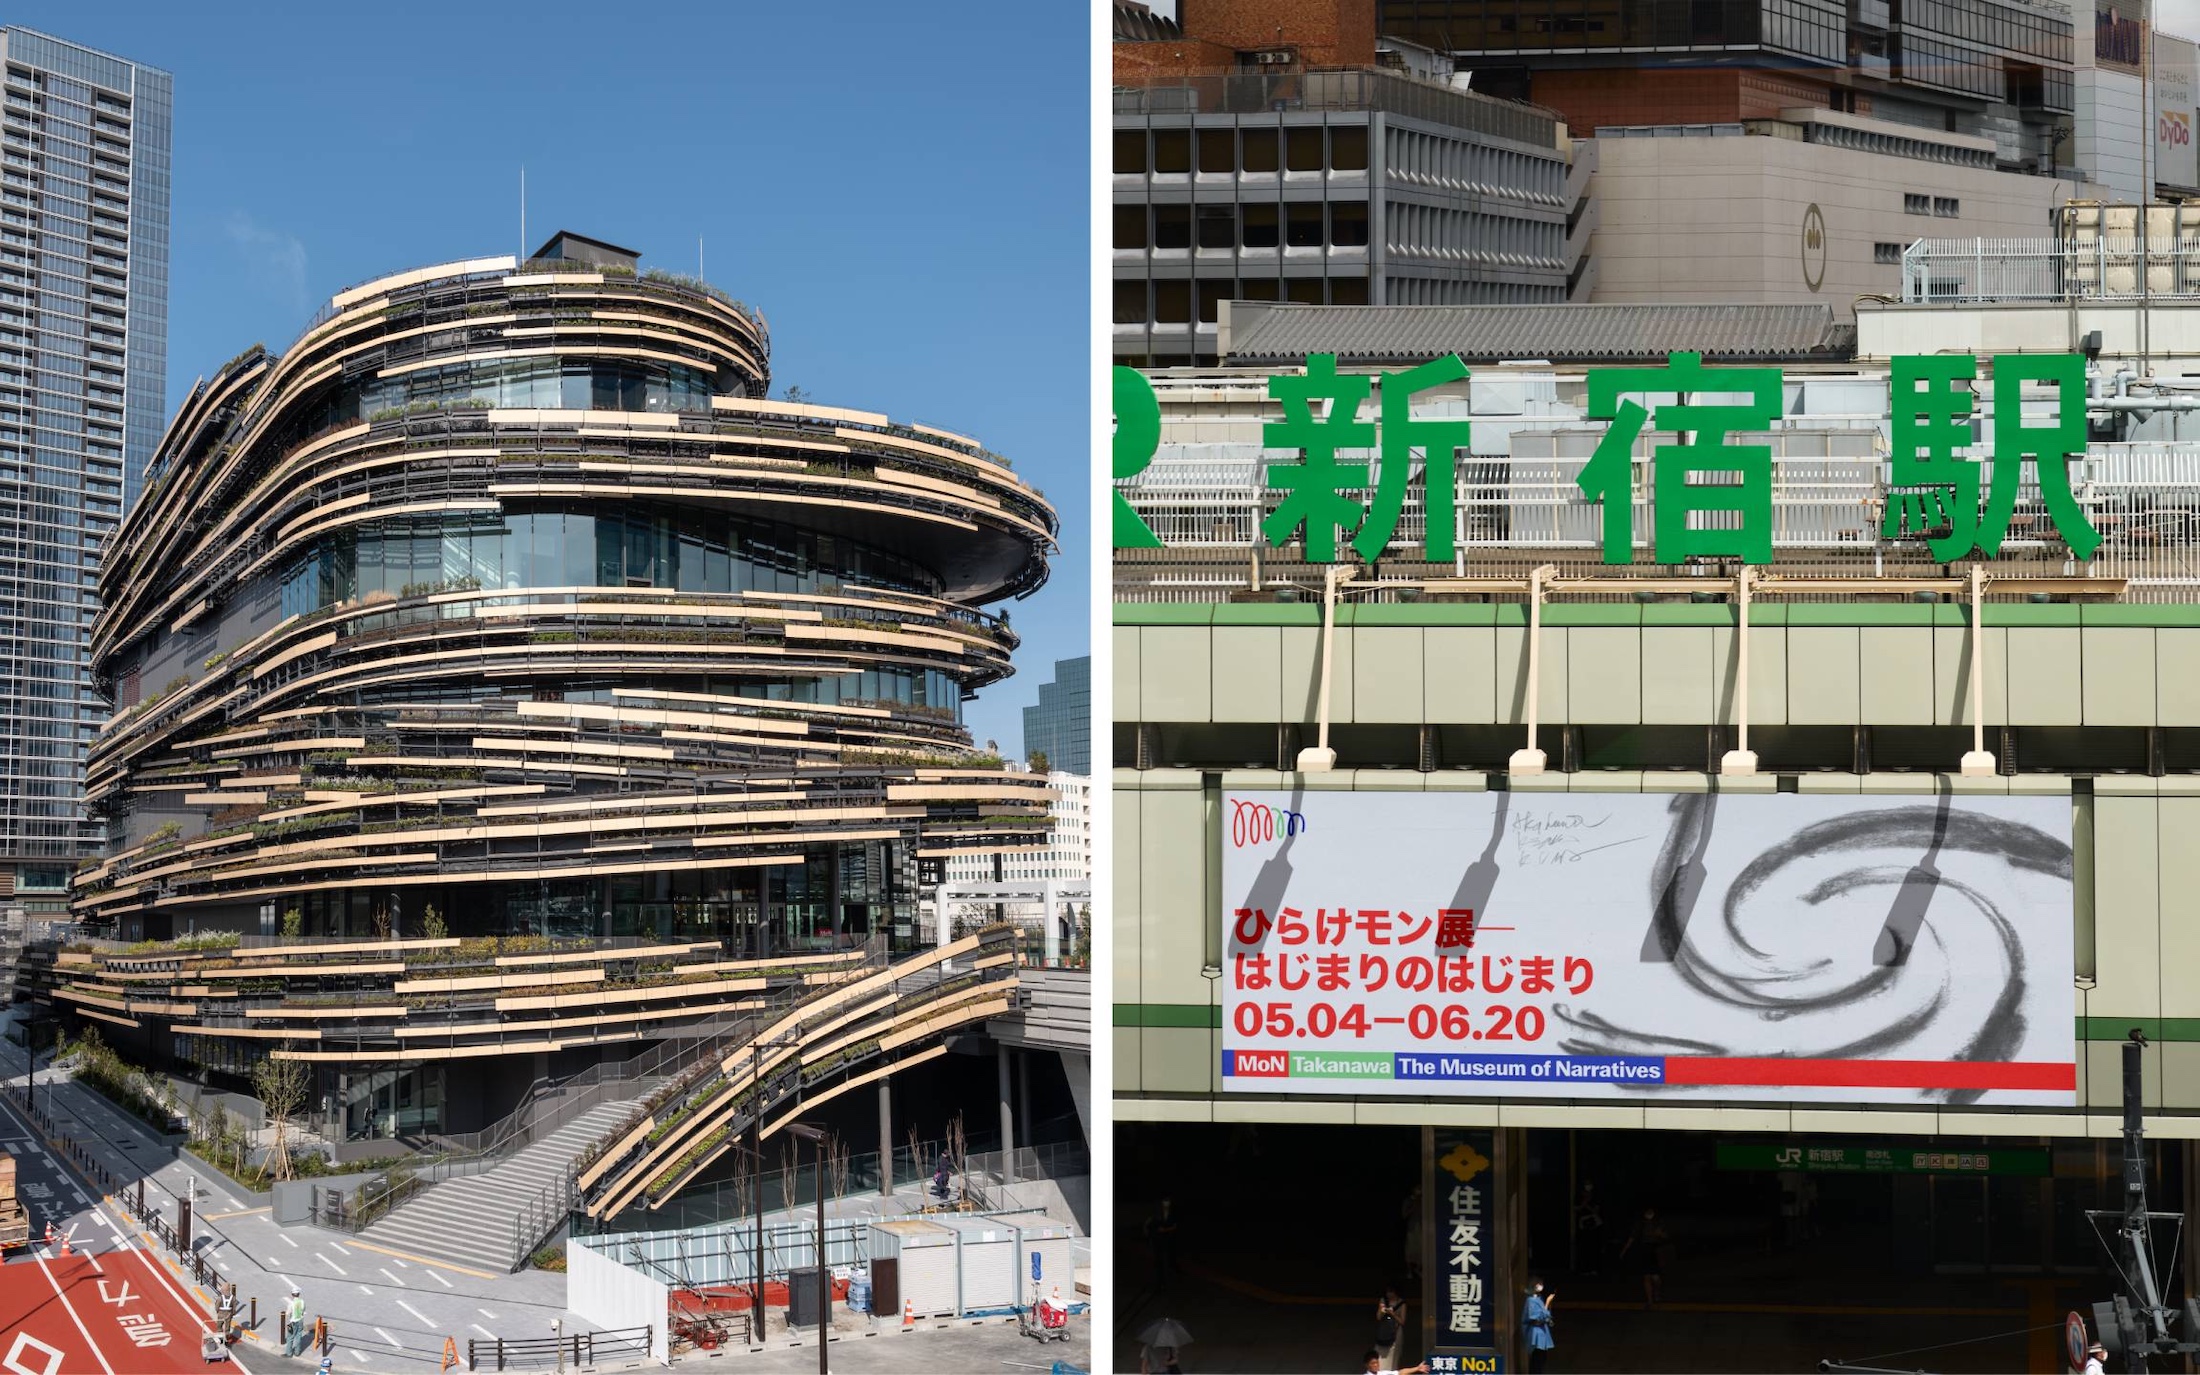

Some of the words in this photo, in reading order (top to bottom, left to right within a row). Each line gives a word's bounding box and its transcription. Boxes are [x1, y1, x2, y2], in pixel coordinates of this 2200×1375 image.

[2160, 118, 2189, 150] DyDo
[1234, 952, 1594, 995] はじまりのはじまり
[1237, 1056, 1286, 1074] MoN
[1293, 1056, 1392, 1075] Takanawa
[1399, 1057, 1436, 1075] The
[1440, 1059, 1527, 1077] Museum
[1530, 1060, 1551, 1077] of
[1556, 1060, 1661, 1079] Narratives
[1775, 1148, 1802, 1163] JR
[1808, 1149, 1844, 1162] 新宿駅
[1448, 1185, 1482, 1333] 住友不動産
[1431, 1357, 1458, 1371] 東京
[1461, 1356, 1496, 1372] No.1
